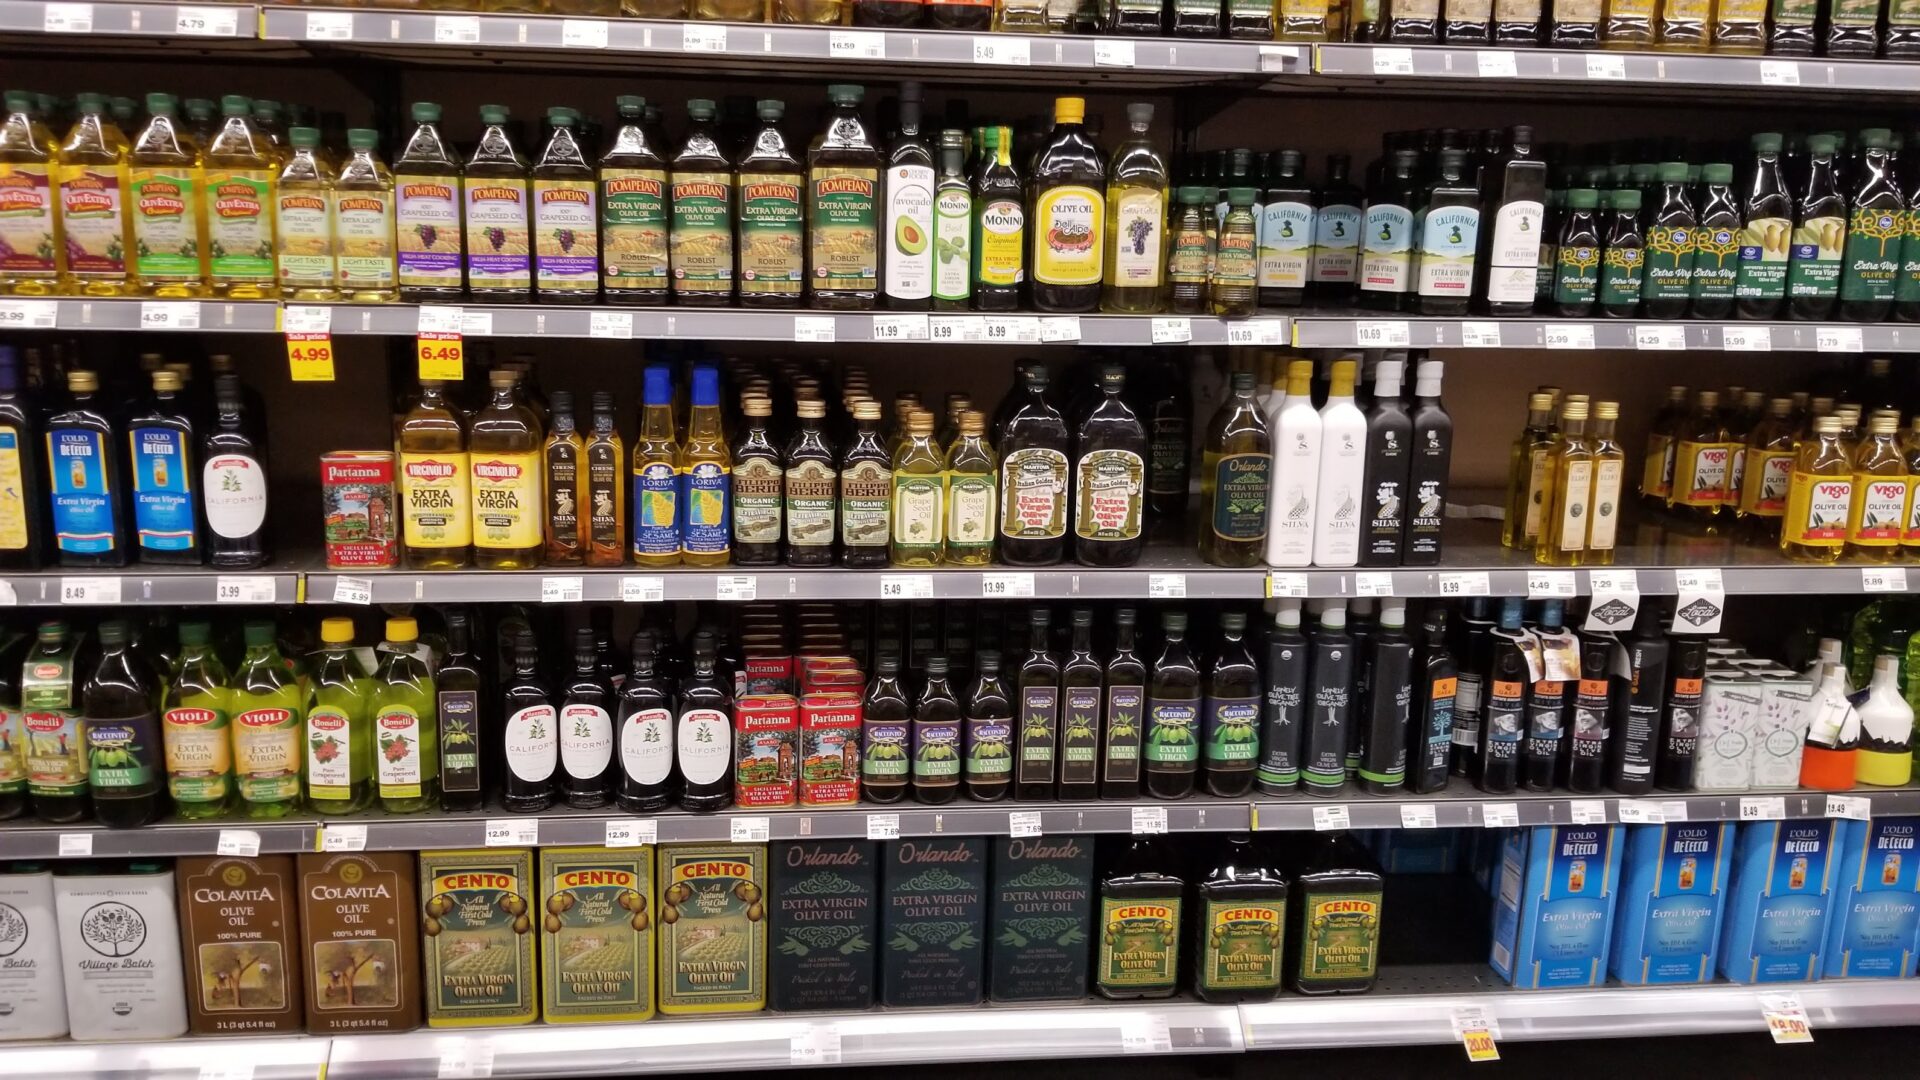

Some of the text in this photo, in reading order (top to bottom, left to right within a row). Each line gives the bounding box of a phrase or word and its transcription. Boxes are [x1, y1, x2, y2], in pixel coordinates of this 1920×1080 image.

[178, 19, 205, 29] 4.79
[976, 47, 993, 58] 5.49
[404, 184, 450, 199] POMPEIAN
[609, 180, 658, 195] POMPEIAN
[676, 184, 725, 200] POMPEIAN
[820, 180, 868, 195] POMPEIAN
[474, 186, 518, 202] POMPEIAN
[544, 189, 588, 204] POMPEIAN
[748, 186, 796, 200] POMPEIAN
[608, 200, 660, 210] EXTRA VIRGIN
[818, 201, 871, 210] EXTRA VIRGIN
[896, 197, 932, 206] avocado
[674, 204, 726, 214] EXTRA VIRGIN
[746, 206, 798, 216] EXTRA VIRGIN
[908, 206, 919, 215] oil
[1052, 204, 1094, 214] OLIVE OIL
[985, 216, 1022, 226] MONINI
[758, 258, 786, 266] ROBUST
[0, 312, 24, 321] 5.99
[143, 312, 168, 322] 4.99
[876, 326, 898, 337] 11.99
[934, 327, 952, 338] 8.99
[988, 326, 1006, 337] 8.99
[1230, 330, 1252, 342] 10.69
[1360, 330, 1380, 340] 10.69
[308, 334, 328, 342] price
[438, 333, 458, 341] price
[1548, 336, 1568, 344] 2.99
[1639, 336, 1660, 344] 4.29
[1725, 338, 1745, 346] 5.99
[1819, 338, 1838, 346] 7.79
[292, 348, 330, 361] 4.99
[421, 347, 460, 361] 6.49
[408, 464, 452, 476] VIRGINOLIO
[476, 464, 518, 477] VIRGINOLIO
[1229, 460, 1268, 472] Orlando
[328, 466, 380, 481] Partanna
[736, 485, 781, 493] BERIO
[789, 488, 834, 496] BERIO
[845, 488, 890, 497] BERIO
[412, 490, 450, 499] EXTRA
[480, 490, 516, 500] EXTRA
[411, 498, 453, 508] VIRGIN
[478, 499, 518, 509] VIRGIN
[740, 496, 776, 505] ORGANIC
[794, 500, 829, 508] ORGANIC
[850, 500, 886, 508] ORGANIC
[1019, 504, 1051, 512] Virgin
[1094, 504, 1127, 512] Virgin
[1282, 520, 1310, 528] SILVA
[1329, 520, 1356, 528] SILVA
[1413, 518, 1441, 526] SILVA
[1443, 582, 1459, 592] 8.99
[1530, 582, 1550, 590] 4.49
[1864, 578, 1882, 586] 5.89
[220, 587, 240, 597] 3.99
[884, 586, 901, 594] 5.49
[984, 582, 1005, 593] 13.99
[66, 588, 84, 598] 8.49
[351, 592, 368, 601] 5.99
[1596, 606, 1629, 618] Local
[1682, 606, 1716, 618] Local
[26, 716, 59, 727] Bonelli
[171, 712, 209, 722] VIOLI
[244, 711, 284, 723] VIOLI
[745, 714, 790, 728] Partanna
[810, 712, 856, 726] Partanna
[314, 718, 341, 728] Bonelli
[384, 718, 411, 727] Bonelli
[178, 744, 208, 752] EXTRA
[250, 745, 284, 754] EXTRA
[174, 752, 212, 760] VIRGIN
[248, 752, 286, 762] VIRGIN
[1224, 751, 1252, 759] VIRGIN
[1026, 825, 1042, 833] 7.69
[1678, 829, 1706, 838] L'OLIO
[1790, 828, 1818, 838] L'OLIO
[1882, 826, 1913, 834] L'OLIO
[608, 831, 630, 839] 12.99
[1567, 831, 1596, 840] L'OLIO
[899, 842, 974, 864] Orlando
[1008, 839, 1082, 860] Orlando
[787, 845, 863, 867] Orlando
[682, 862, 746, 878] CENTO
[443, 874, 510, 890] CENTO
[564, 871, 630, 886] CENTO
[194, 887, 275, 903] COLAVITA
[311, 884, 392, 900] COLAVITA
[1002, 890, 1086, 902] EXTRA VIRGIN
[782, 898, 868, 910] EXTRA VIRGIN
[892, 894, 978, 906] EXTRA VIRGIN
[220, 906, 255, 916] OLIVE
[336, 904, 370, 914] OLIVE
[905, 906, 965, 917] OLIVE OIL
[1014, 902, 1073, 912] OLIVE OIL
[1324, 901, 1370, 913] CENTO
[794, 910, 856, 921] OLIVE OIL
[1118, 907, 1166, 919] CENTO
[1224, 909, 1272, 921] CENTO
[228, 917, 248, 926] OIL
[344, 915, 364, 924] OIL
[2, 958, 38, 968] Batch
[1772, 1020, 1806, 1033] 18.00
[1468, 1038, 1494, 1052] 20.00
